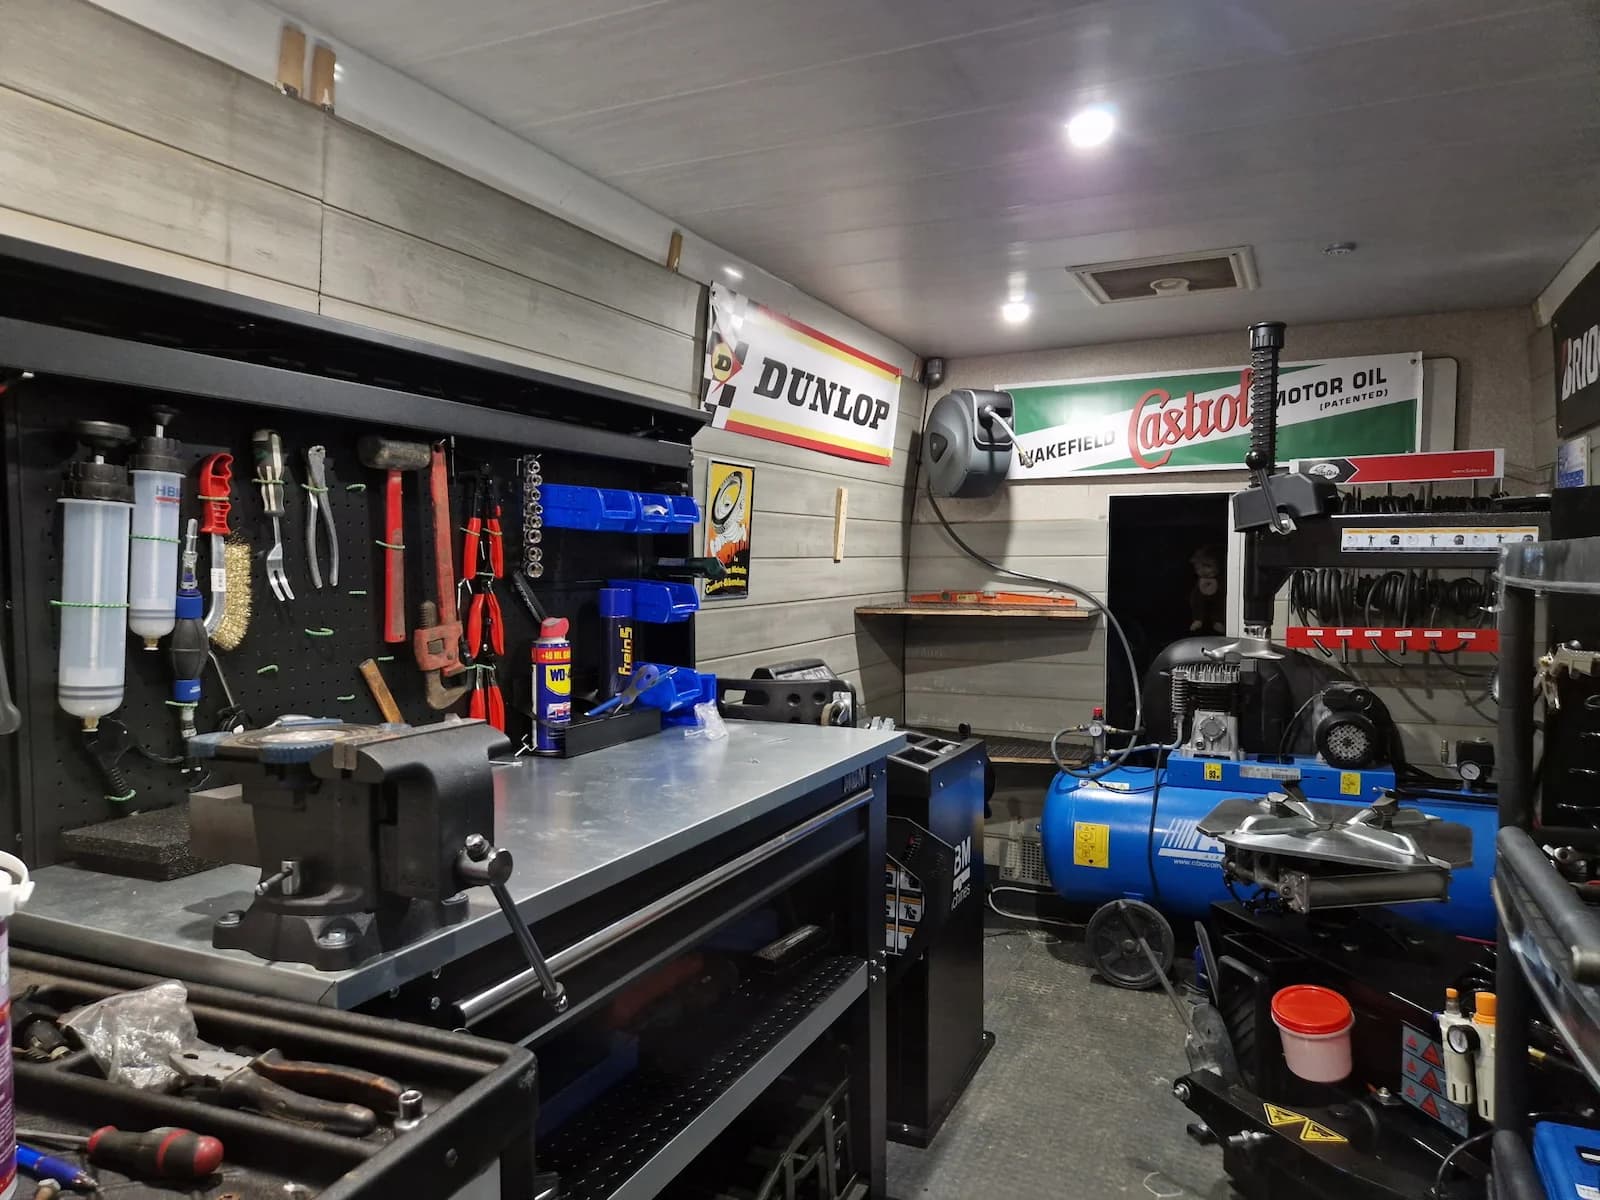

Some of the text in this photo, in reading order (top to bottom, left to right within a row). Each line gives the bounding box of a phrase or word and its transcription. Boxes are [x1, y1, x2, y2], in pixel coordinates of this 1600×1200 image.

[1353, 367, 1387, 389] OIL
[1561, 324, 1600, 401] BRID
[753, 357, 890, 430] DUNLOP
[1128, 368, 1255, 469] Castrol
[1320, 389, 1388, 411] (PATENTED)
[1018, 430, 1115, 467] WAKEFIELD
